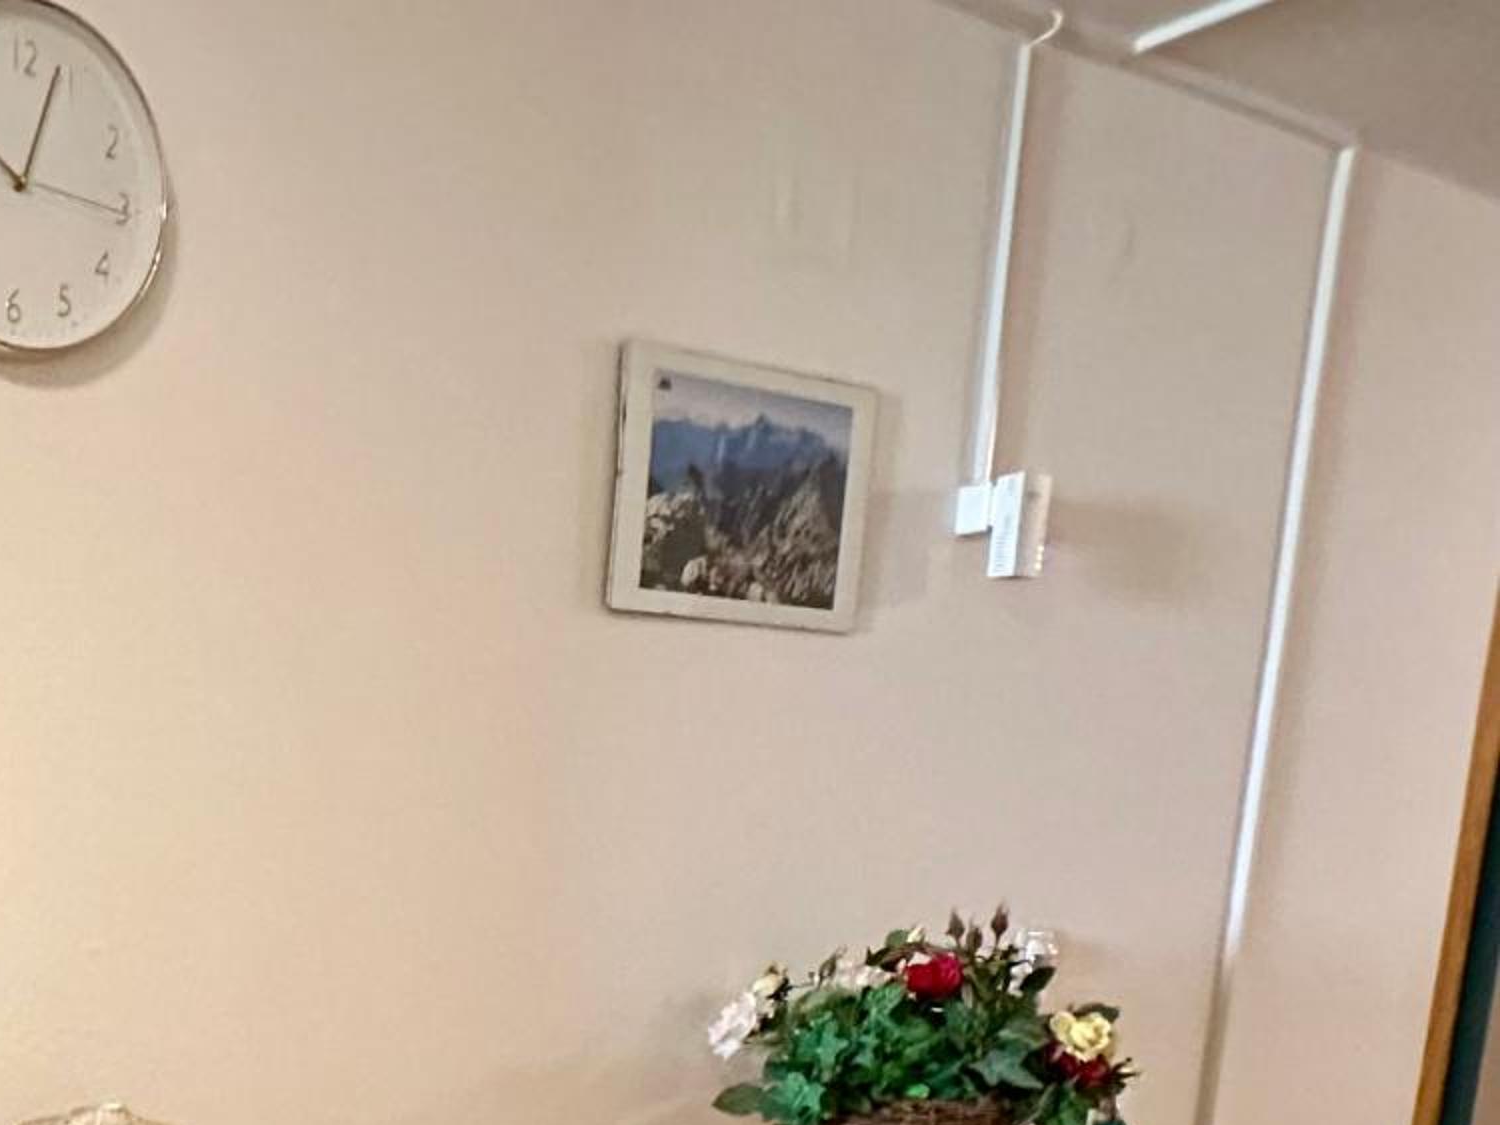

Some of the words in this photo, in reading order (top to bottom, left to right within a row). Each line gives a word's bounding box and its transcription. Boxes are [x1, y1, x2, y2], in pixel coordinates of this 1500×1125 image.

[14, 36, 38, 78] 12
[105, 123, 119, 160] 2
[115, 192, 130, 225] 3
[95, 251, 109, 286] 4
[6, 289, 21, 324] 6
[57, 284, 72, 318] 5
